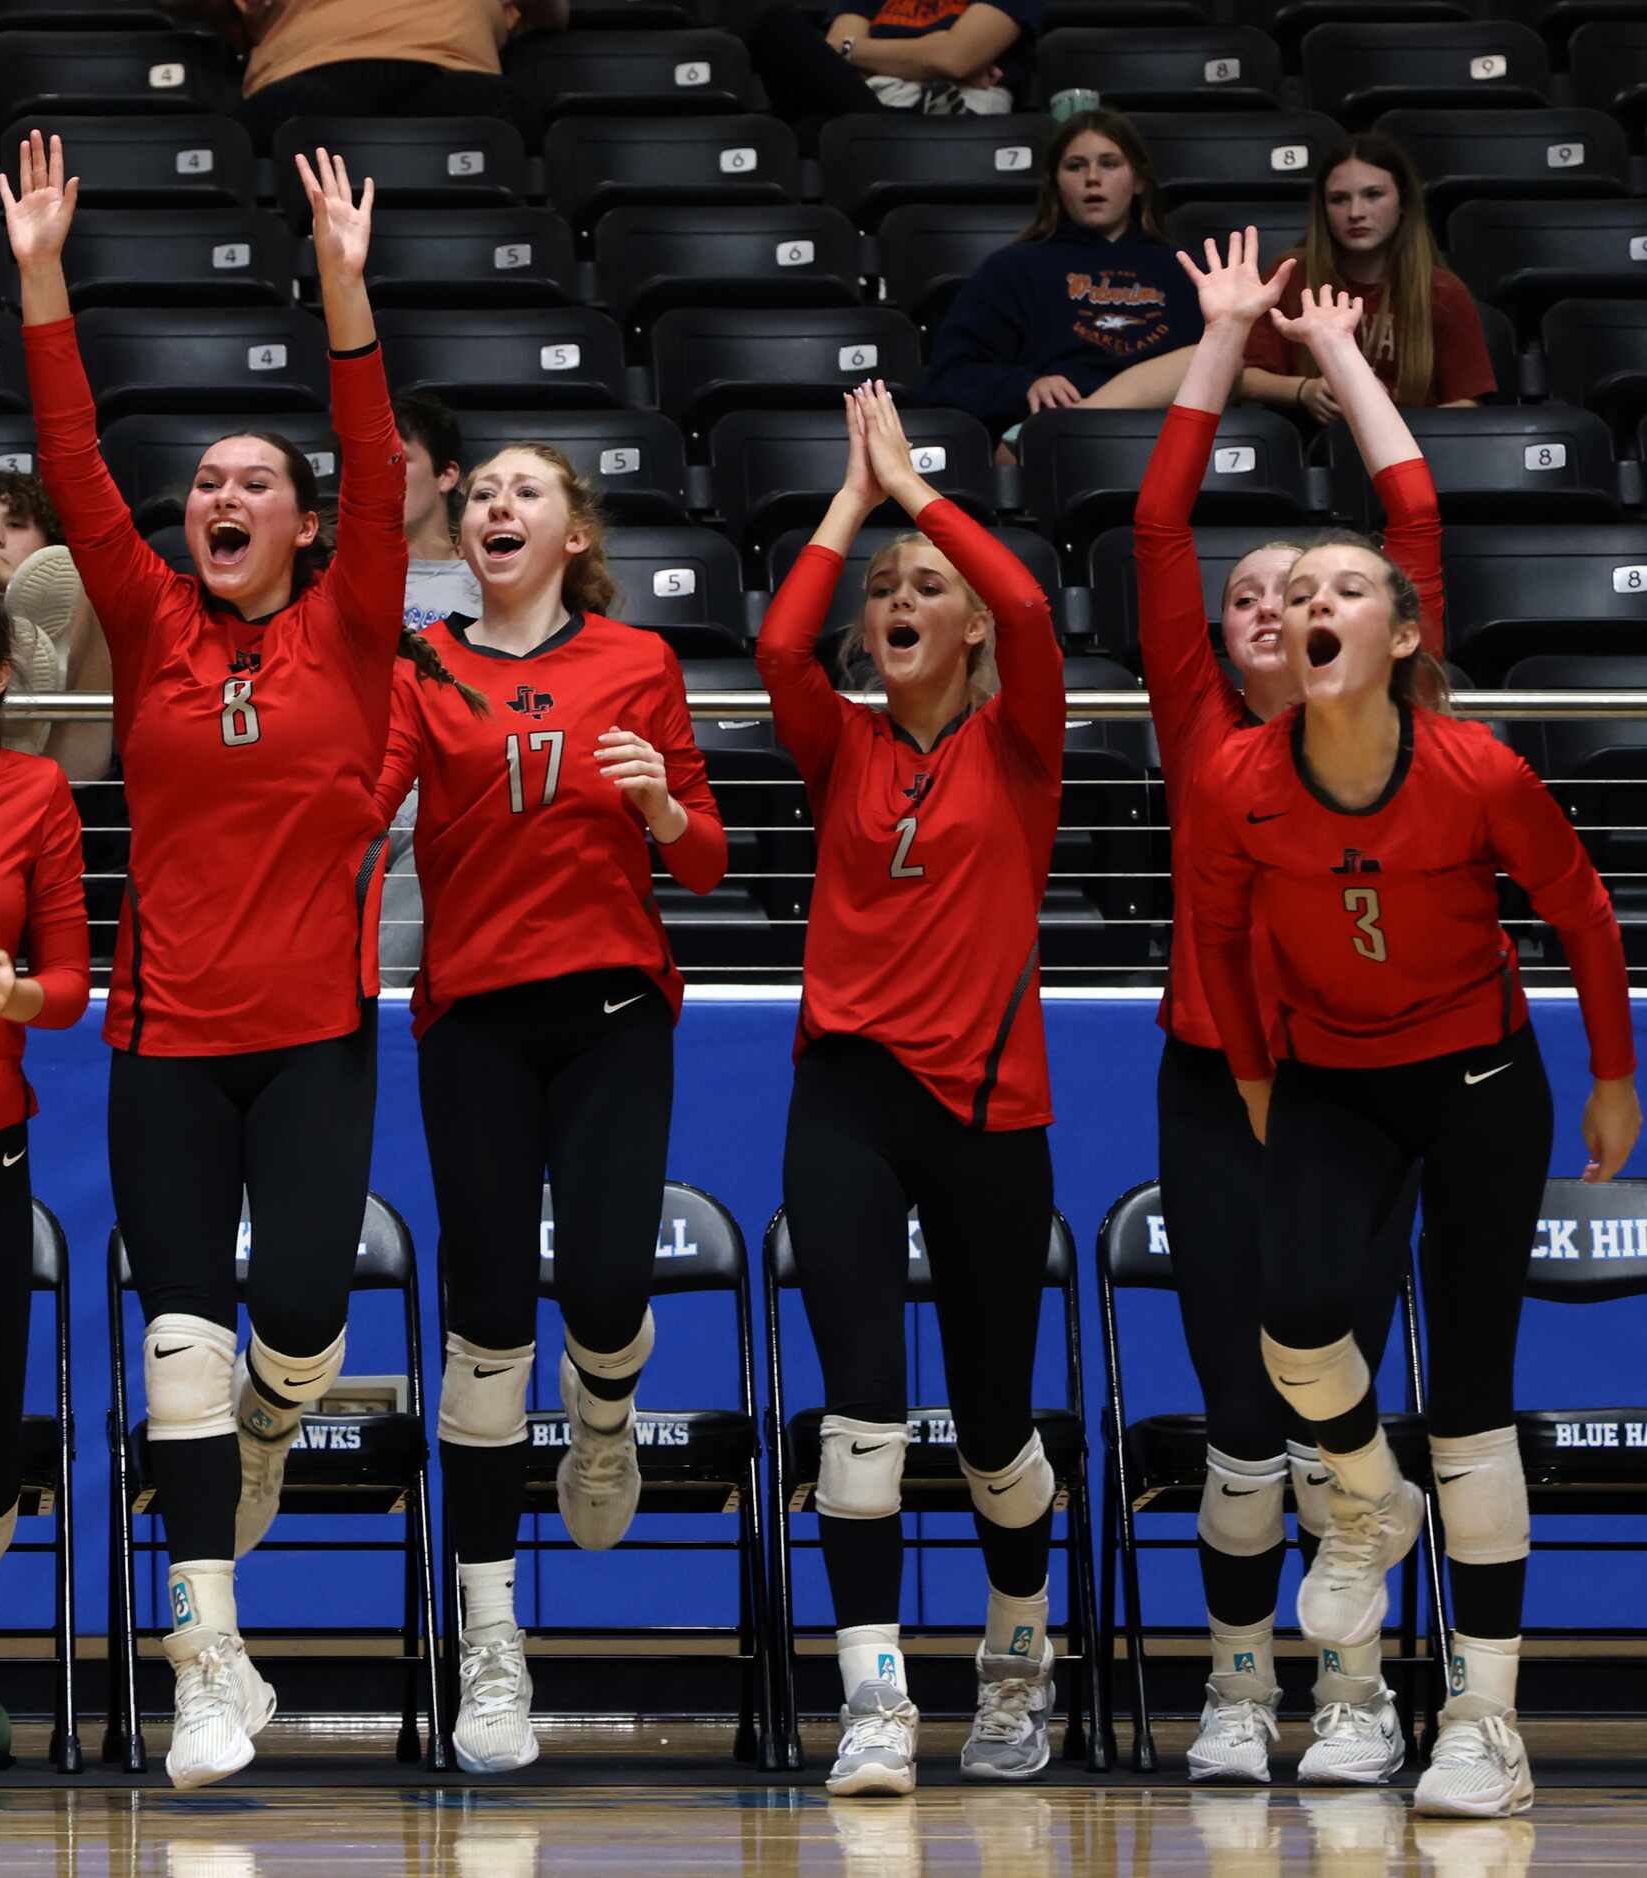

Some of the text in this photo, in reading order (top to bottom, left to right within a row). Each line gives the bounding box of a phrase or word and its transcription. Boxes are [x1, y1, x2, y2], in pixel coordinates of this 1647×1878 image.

[686, 66, 699, 81] 6
[1216, 62, 1230, 78] 8
[1482, 58, 1495, 73] 9
[188, 154, 200, 168] 4
[459, 154, 472, 171] 5
[732, 152, 745, 167] 6
[1007, 150, 1019, 166] 7
[1283, 150, 1296, 165] 8
[1558, 147, 1572, 161] 9
[224, 249, 237, 262] 4
[507, 247, 520, 265] 5
[788, 246, 802, 261] 6
[260, 349, 273, 364] 4
[554, 348, 567, 365] 5
[851, 349, 865, 366] 6
[7, 457, 20, 472] 3
[614, 452, 627, 469] 5
[918, 452, 933, 469] 6
[1228, 451, 1241, 468] 7
[1538, 448, 1553, 465] 8
[668, 574, 681, 592] 5
[1627, 570, 1642, 588] 8
[221, 676, 262, 747] 8
[505, 730, 565, 814] 17
[888, 816, 926, 880] 2
[1343, 887, 1389, 963] 3
[290, 1425, 362, 1450] AWKS
[532, 1422, 689, 1446] BLU WKS
[1555, 1422, 1618, 1448] BLUE
